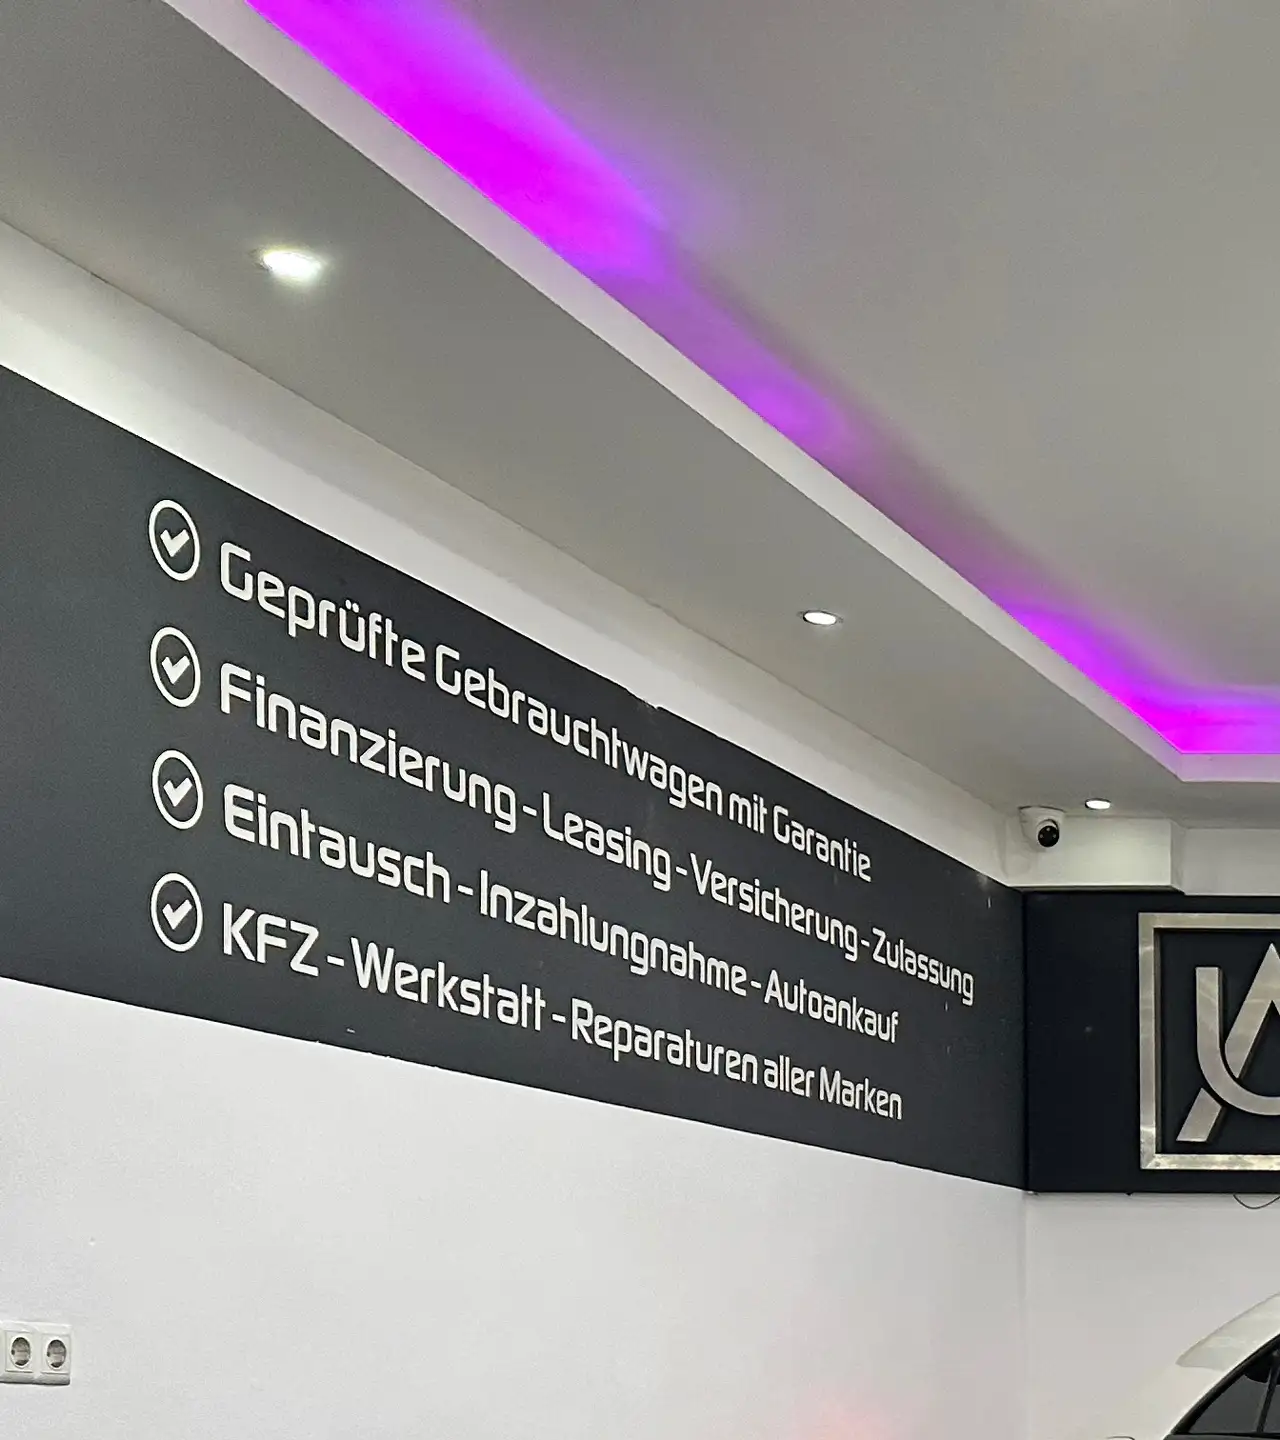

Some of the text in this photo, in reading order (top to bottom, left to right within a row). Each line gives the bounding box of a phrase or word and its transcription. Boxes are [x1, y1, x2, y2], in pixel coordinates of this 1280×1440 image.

[220, 541, 872, 883] Geprüfte Gebrauchtwagen mit Garantie
[220, 662, 517, 834] Finanzierung
[542, 791, 671, 892] Leasing
[690, 852, 858, 962] Versicherung
[872, 927, 974, 1006] Zulassung
[223, 783, 451, 904] Eintausch
[480, 869, 747, 997] Inzahlungnahme
[764, 969, 899, 1044] Autoankauf
[223, 902, 320, 977] KFZ
[350, 937, 547, 1031] Werkstatt
[571, 997, 758, 1085] Reparaturen
[763, 1054, 815, 1098] aller
[819, 1066, 902, 1120] Marken
